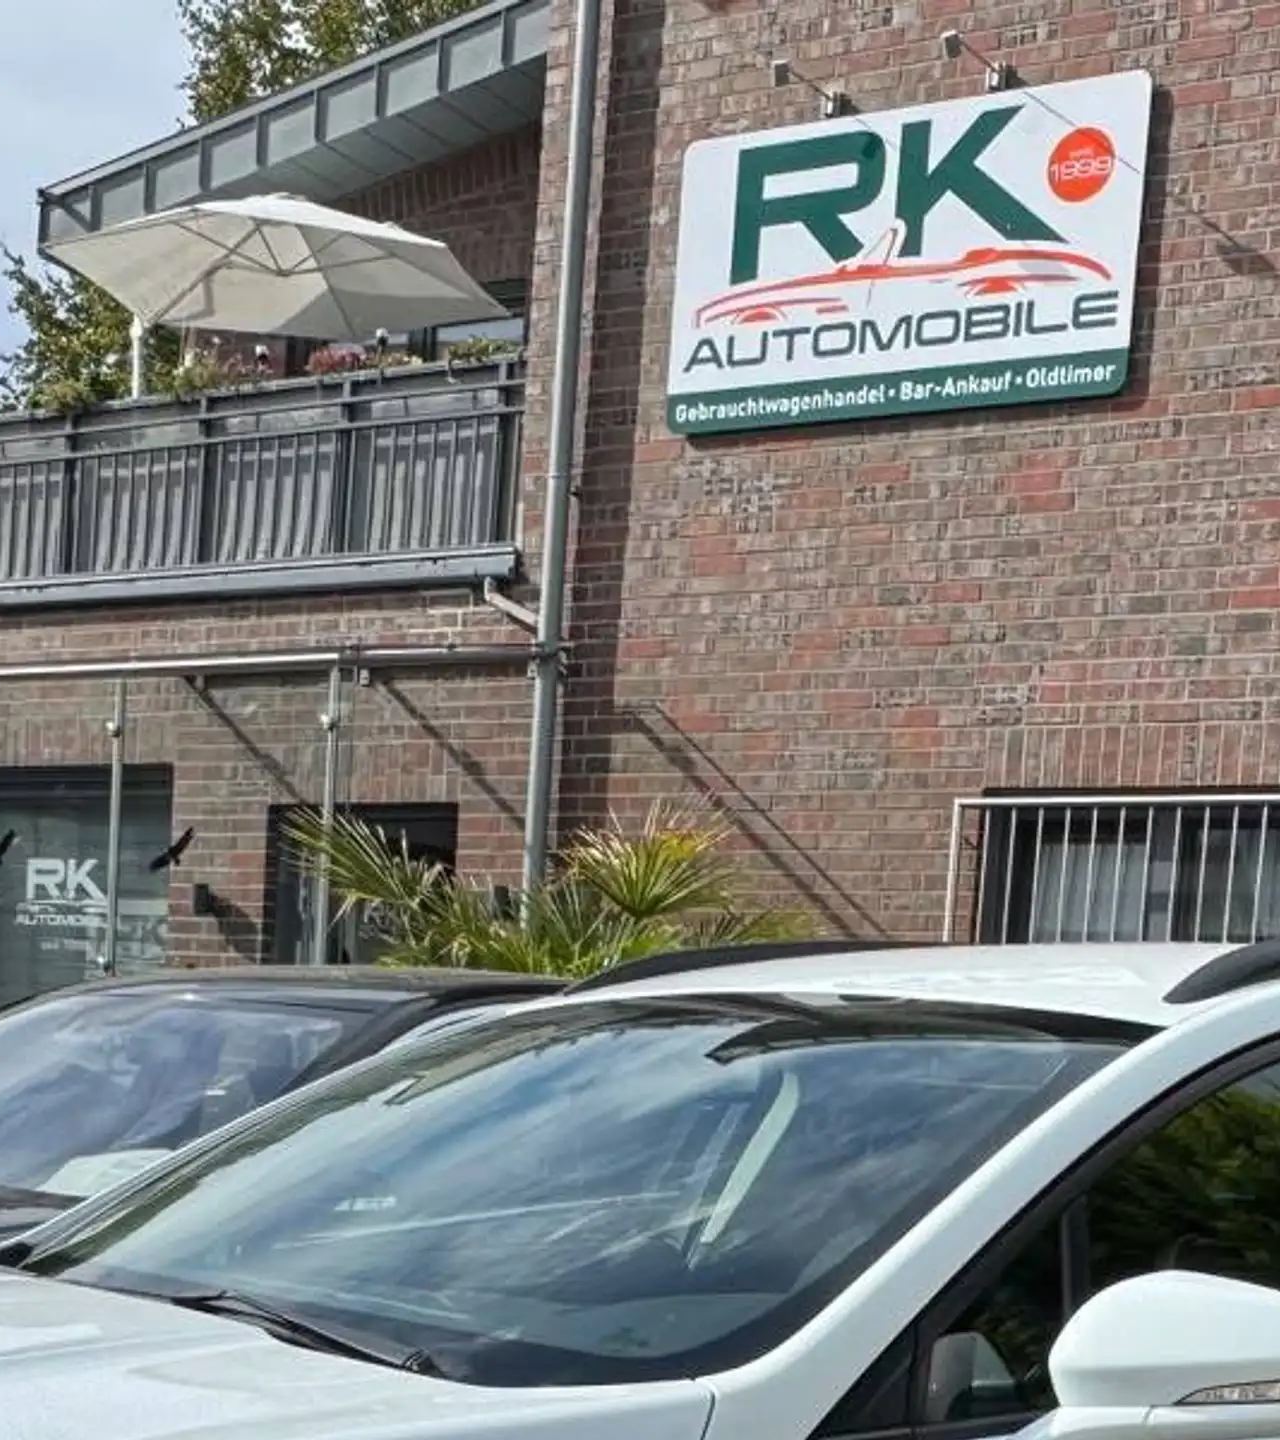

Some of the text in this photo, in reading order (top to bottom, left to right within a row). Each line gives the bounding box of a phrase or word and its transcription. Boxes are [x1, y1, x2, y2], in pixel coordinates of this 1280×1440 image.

[730, 104, 1069, 285] RK
[683, 289, 1119, 373] AUTOMOBILE
[675, 363, 1117, 423] Gebrauchtwagenhandel Bar-Ankauf Oldtimer
[26, 857, 107, 900] RK
